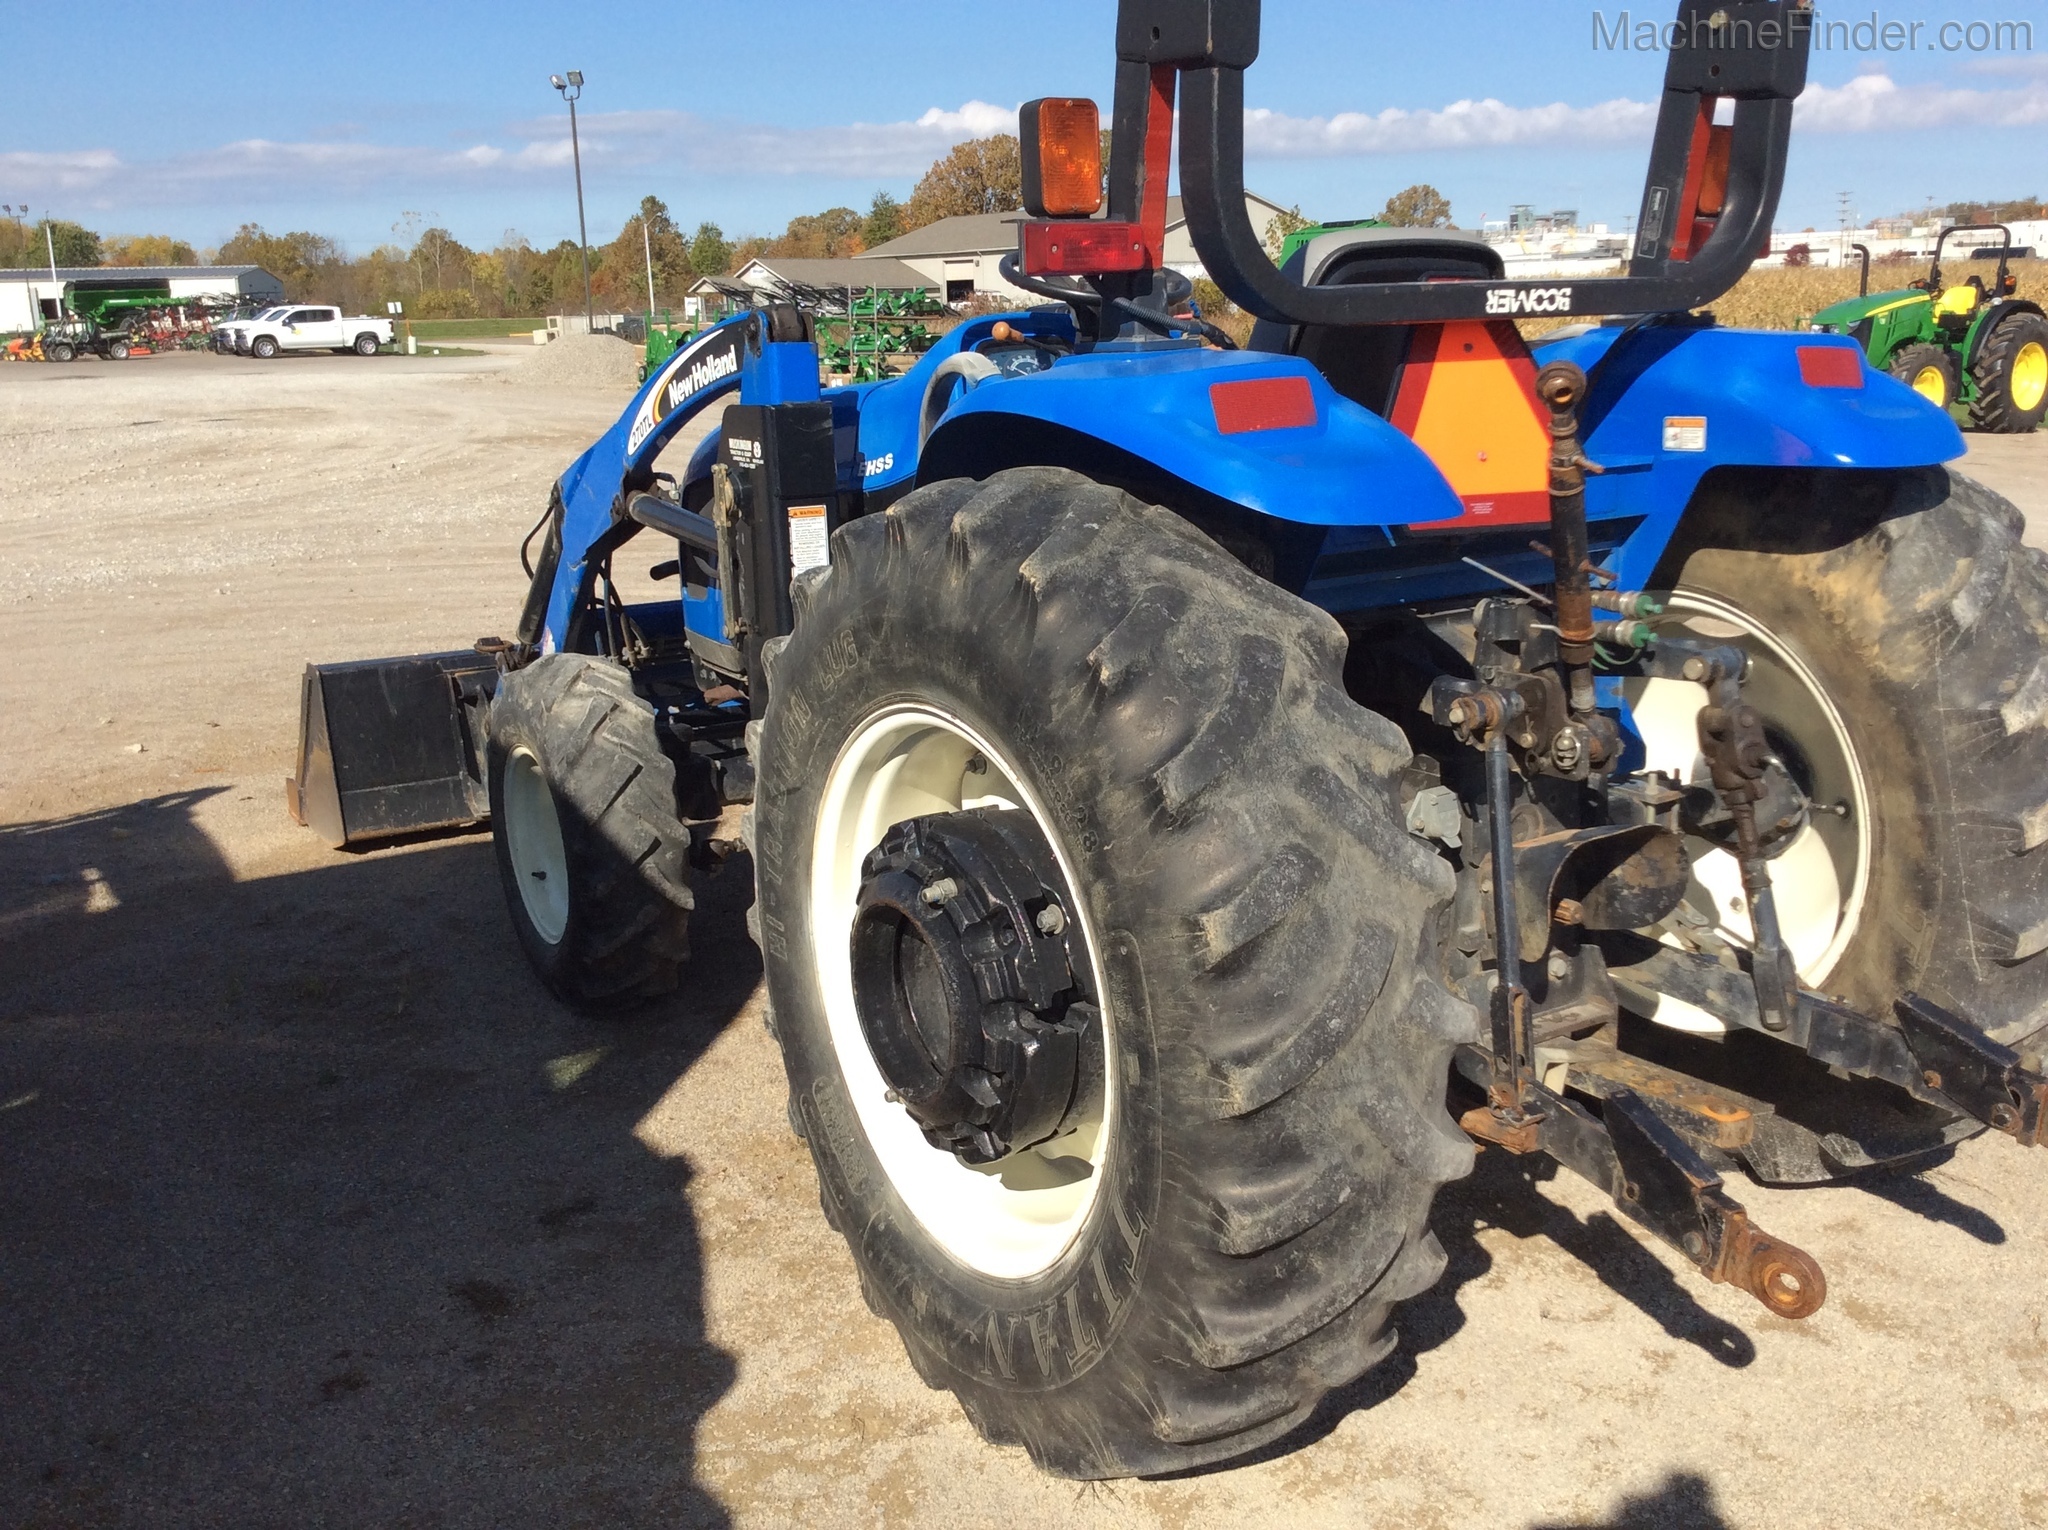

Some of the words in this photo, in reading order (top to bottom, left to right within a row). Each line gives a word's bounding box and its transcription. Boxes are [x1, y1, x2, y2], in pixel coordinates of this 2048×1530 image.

[1485, 287, 1572, 314] BOOMER
[631, 414, 653, 448] 270TL
[813, 629, 859, 691] LUG
[980, 1182, 1151, 1383] TITAN
